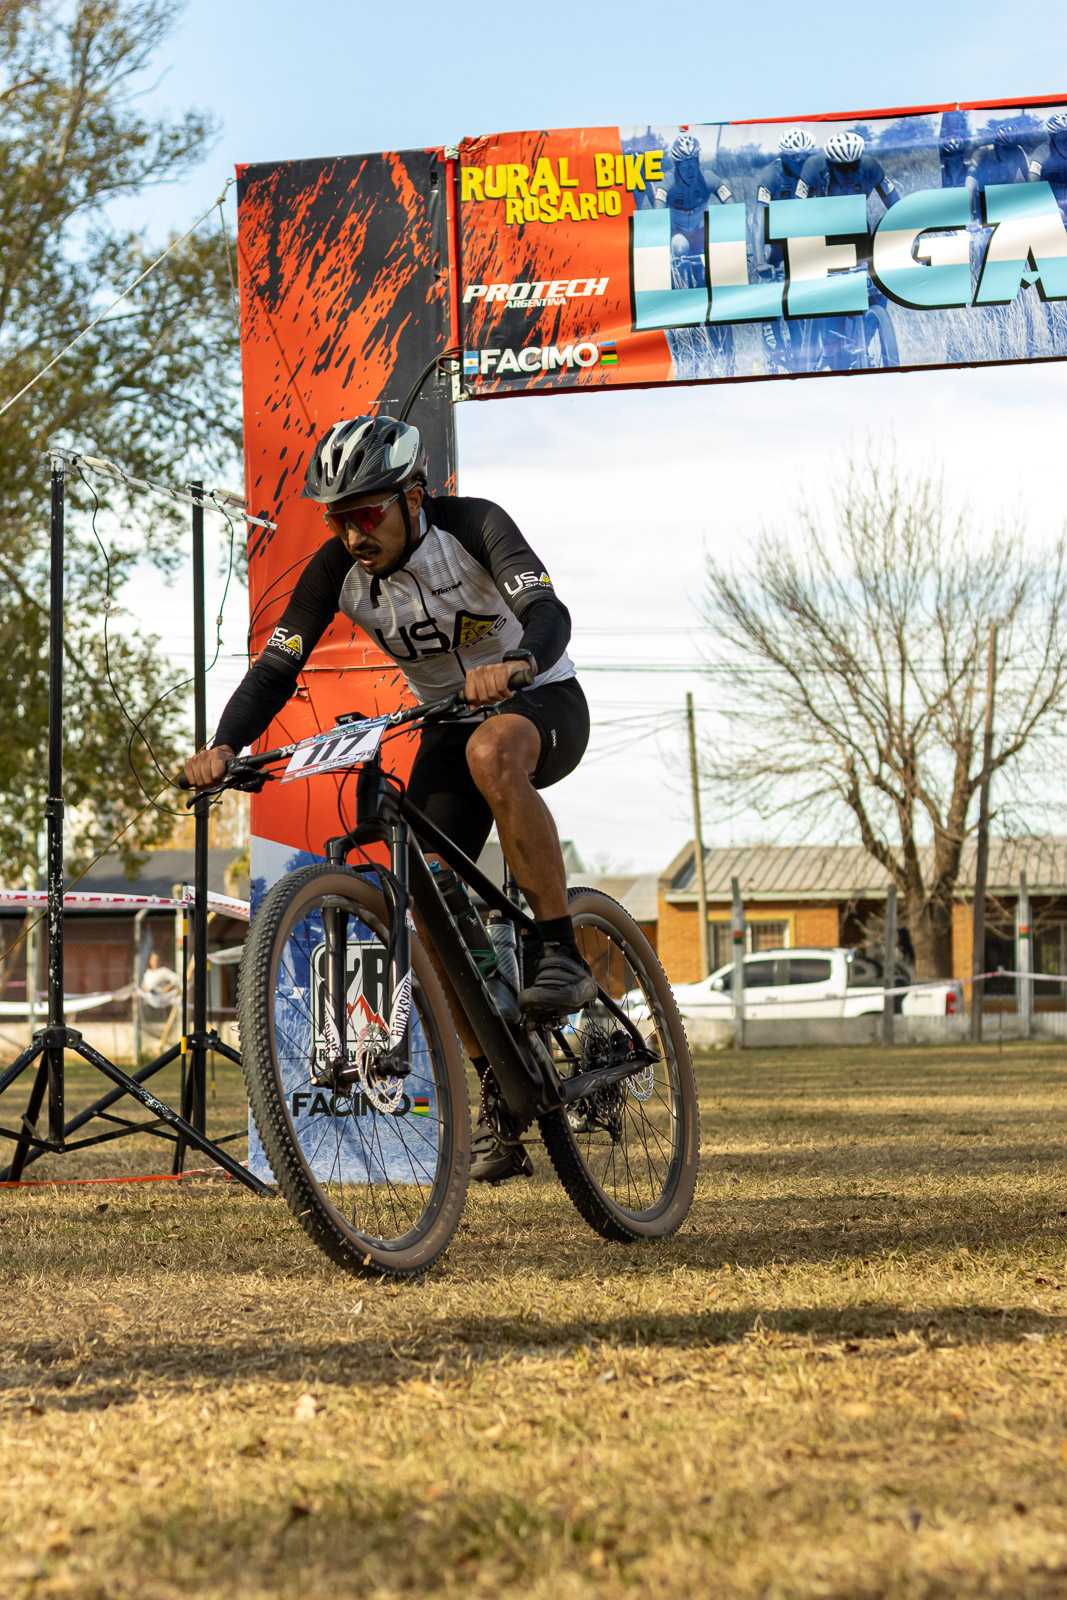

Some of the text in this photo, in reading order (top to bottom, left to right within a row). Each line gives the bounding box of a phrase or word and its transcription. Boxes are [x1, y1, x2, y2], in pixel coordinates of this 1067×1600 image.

[461, 151, 664, 205] RURAL BIKE
[506, 190, 622, 225] ROSARIO
[629, 181, 1067, 332] LLEGA
[462, 277, 610, 304] PROTECH
[504, 297, 567, 309] ARGENTINA
[480, 342, 599, 375] FACIMO
[504, 571, 551, 595] USA
[270, 641, 302, 660] SPORTS
[374, 609, 500, 660] USA
[303, 729, 371, 767] 117
[293, 1092, 411, 1117] FACIMO
